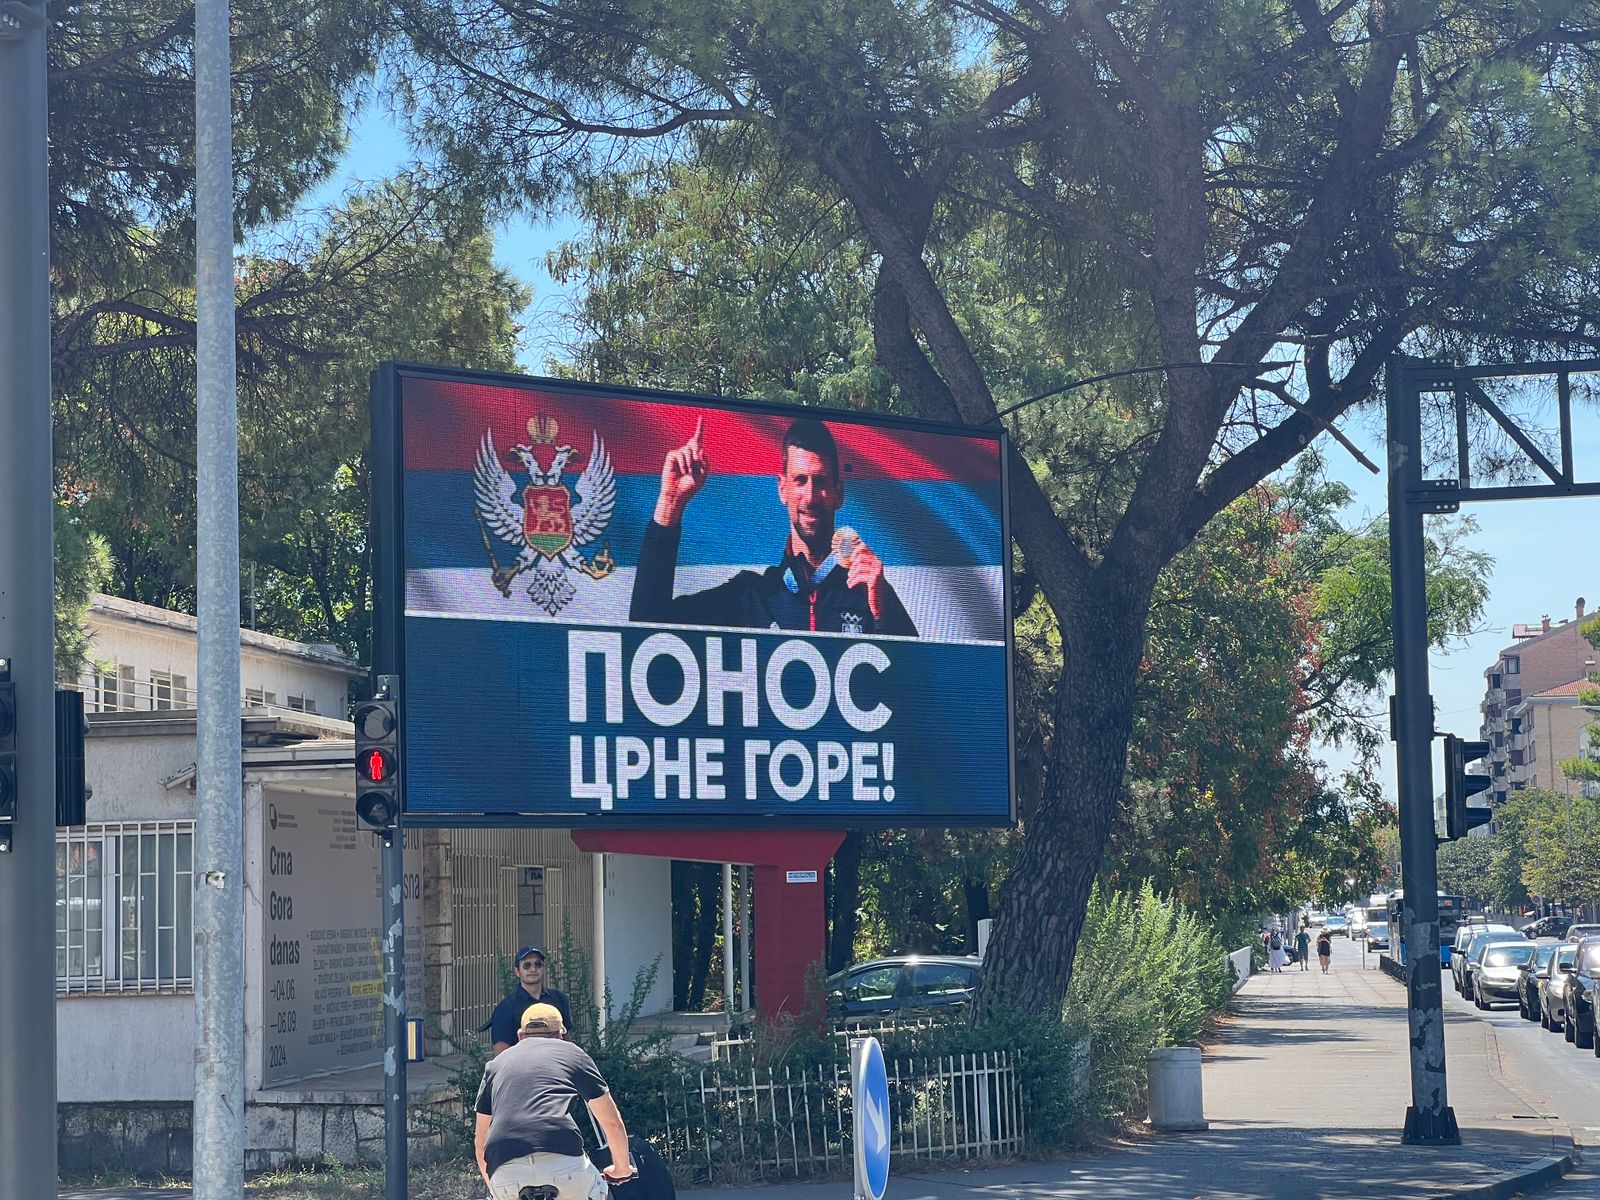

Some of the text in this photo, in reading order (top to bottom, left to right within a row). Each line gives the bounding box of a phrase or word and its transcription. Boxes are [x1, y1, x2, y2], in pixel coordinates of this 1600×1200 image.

[568, 629, 893, 732] ПОНОС
[570, 734, 896, 811] ЦРНЕ ГОРЕ!
[270, 846, 293, 876] Crna
[270, 891, 293, 921] Gora
[270, 934, 300, 966] danas
